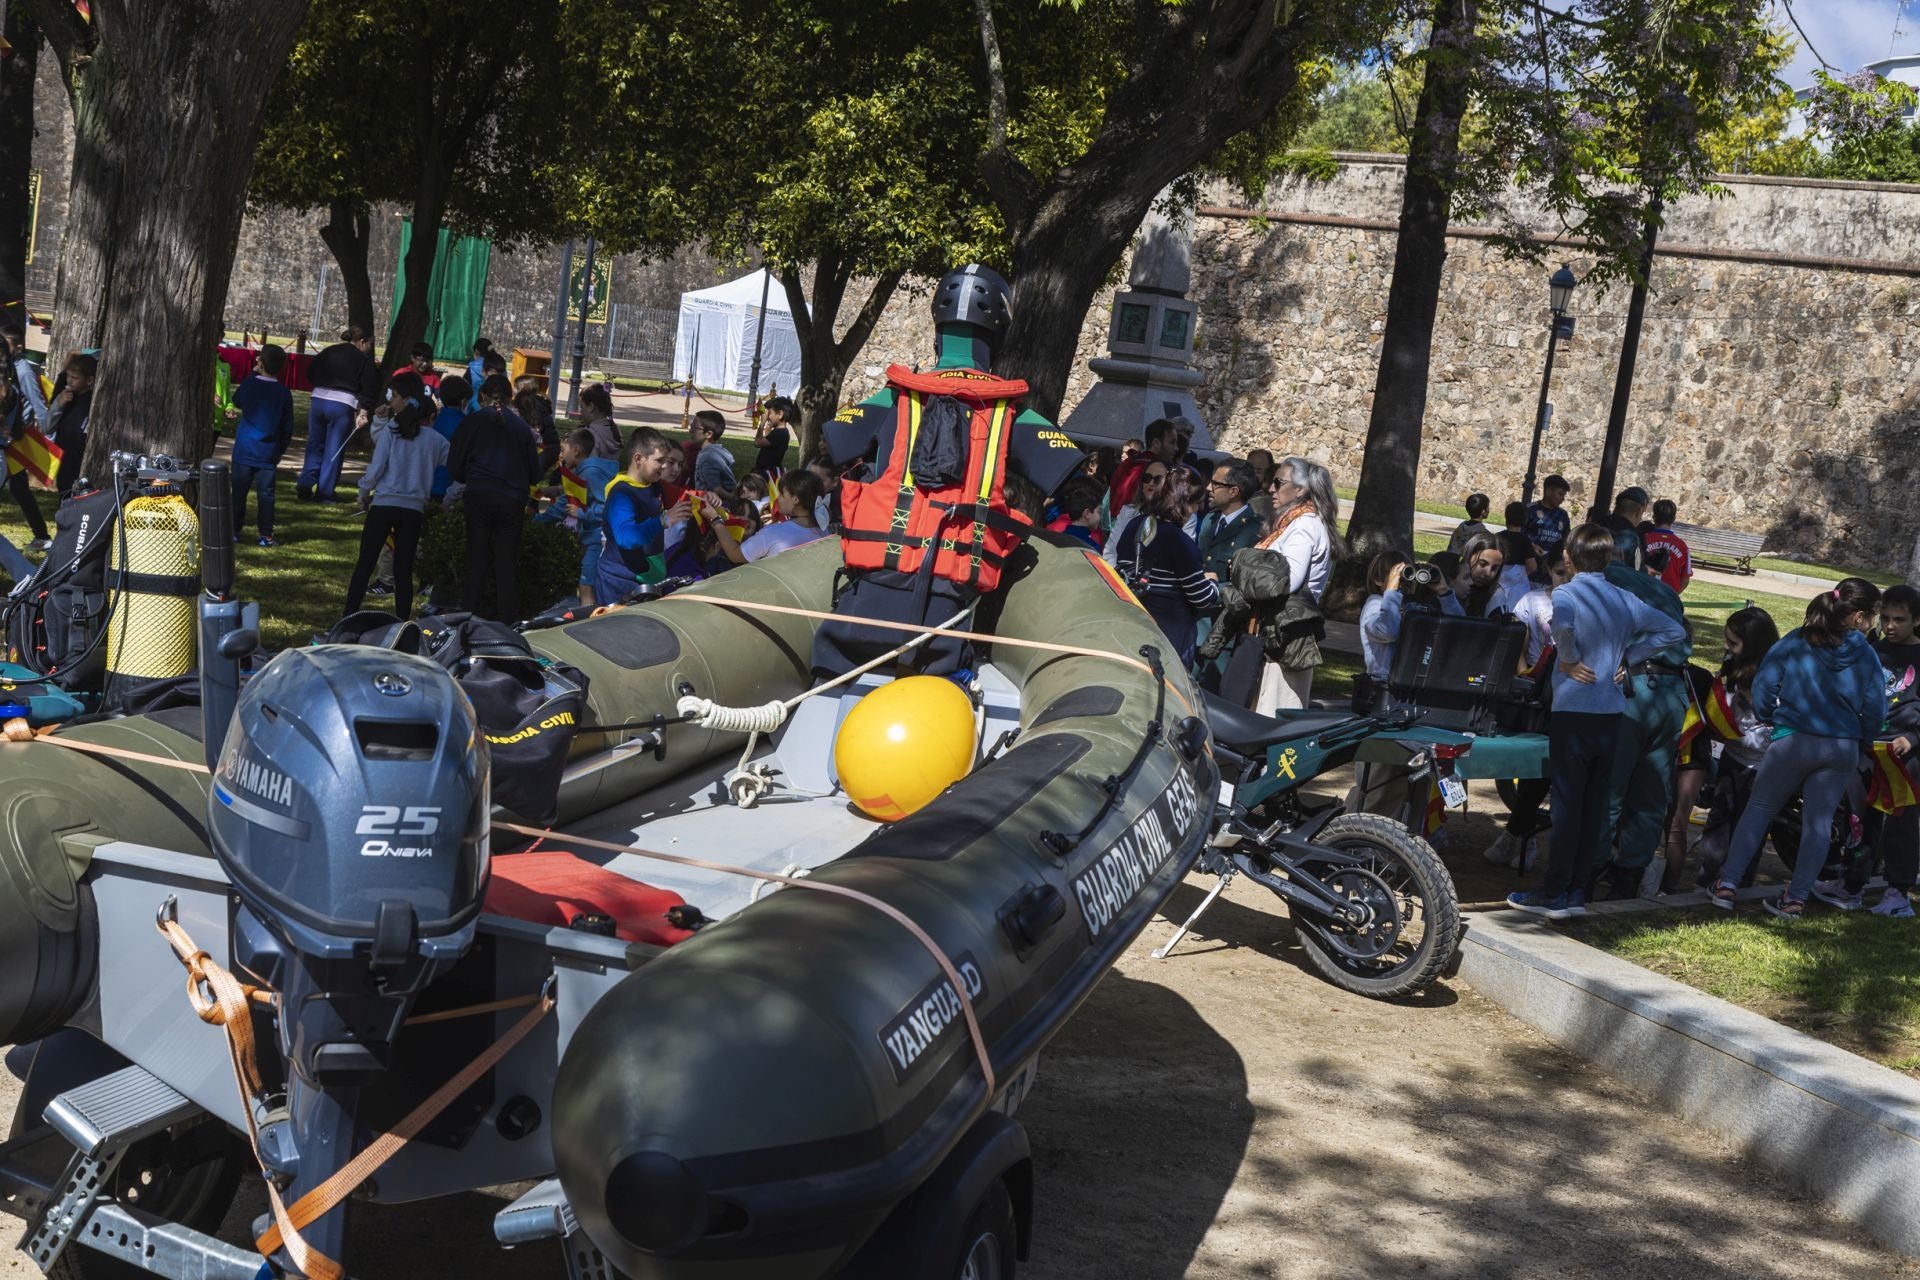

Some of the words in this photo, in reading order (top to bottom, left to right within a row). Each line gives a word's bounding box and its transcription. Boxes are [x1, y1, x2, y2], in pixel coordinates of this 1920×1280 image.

[694, 298, 718, 306] GUARDIA
[719, 301, 733, 309] CIVIL
[70, 514, 90, 573] SCUBARO
[1422, 646, 1432, 665] PELI
[484, 726, 541, 745] ARDIA
[539, 711, 576, 730] CIVIL
[235, 756, 292, 807] YAMAHA
[355, 805, 442, 836] 25
[1075, 836, 1146, 936] GUARDIA
[1133, 808, 1172, 876] CIVIL
[1165, 767, 1198, 837] GEAS
